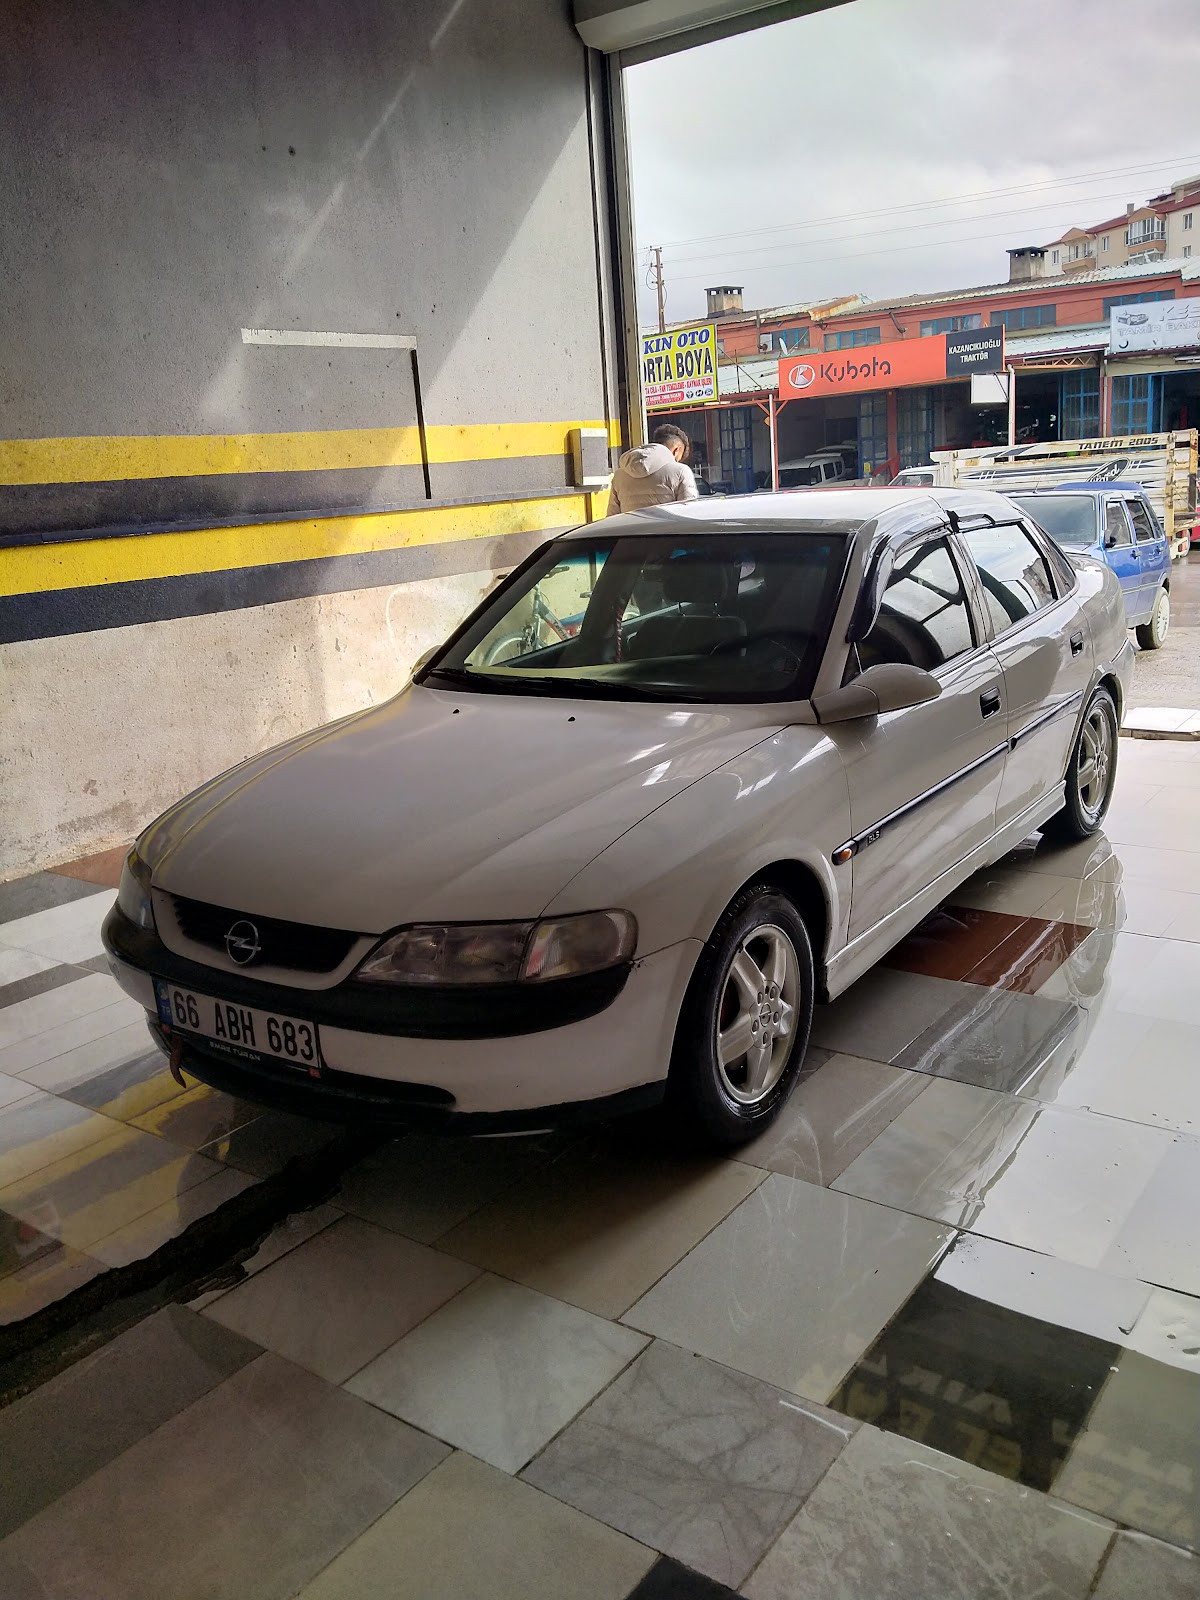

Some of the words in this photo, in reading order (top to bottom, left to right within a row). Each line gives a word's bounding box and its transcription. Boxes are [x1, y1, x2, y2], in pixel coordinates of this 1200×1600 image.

[643, 336, 673, 354] KIN
[677, 329, 710, 348] OTO
[675, 348, 713, 379] BOYA
[820, 356, 891, 382] Kubota
[960, 351, 989, 363] TRAKTÖR
[1128, 437, 1159, 446] 2005
[173, 990, 200, 1029] 66
[214, 1002, 256, 1047] ABH
[266, 1016, 314, 1061] 683
